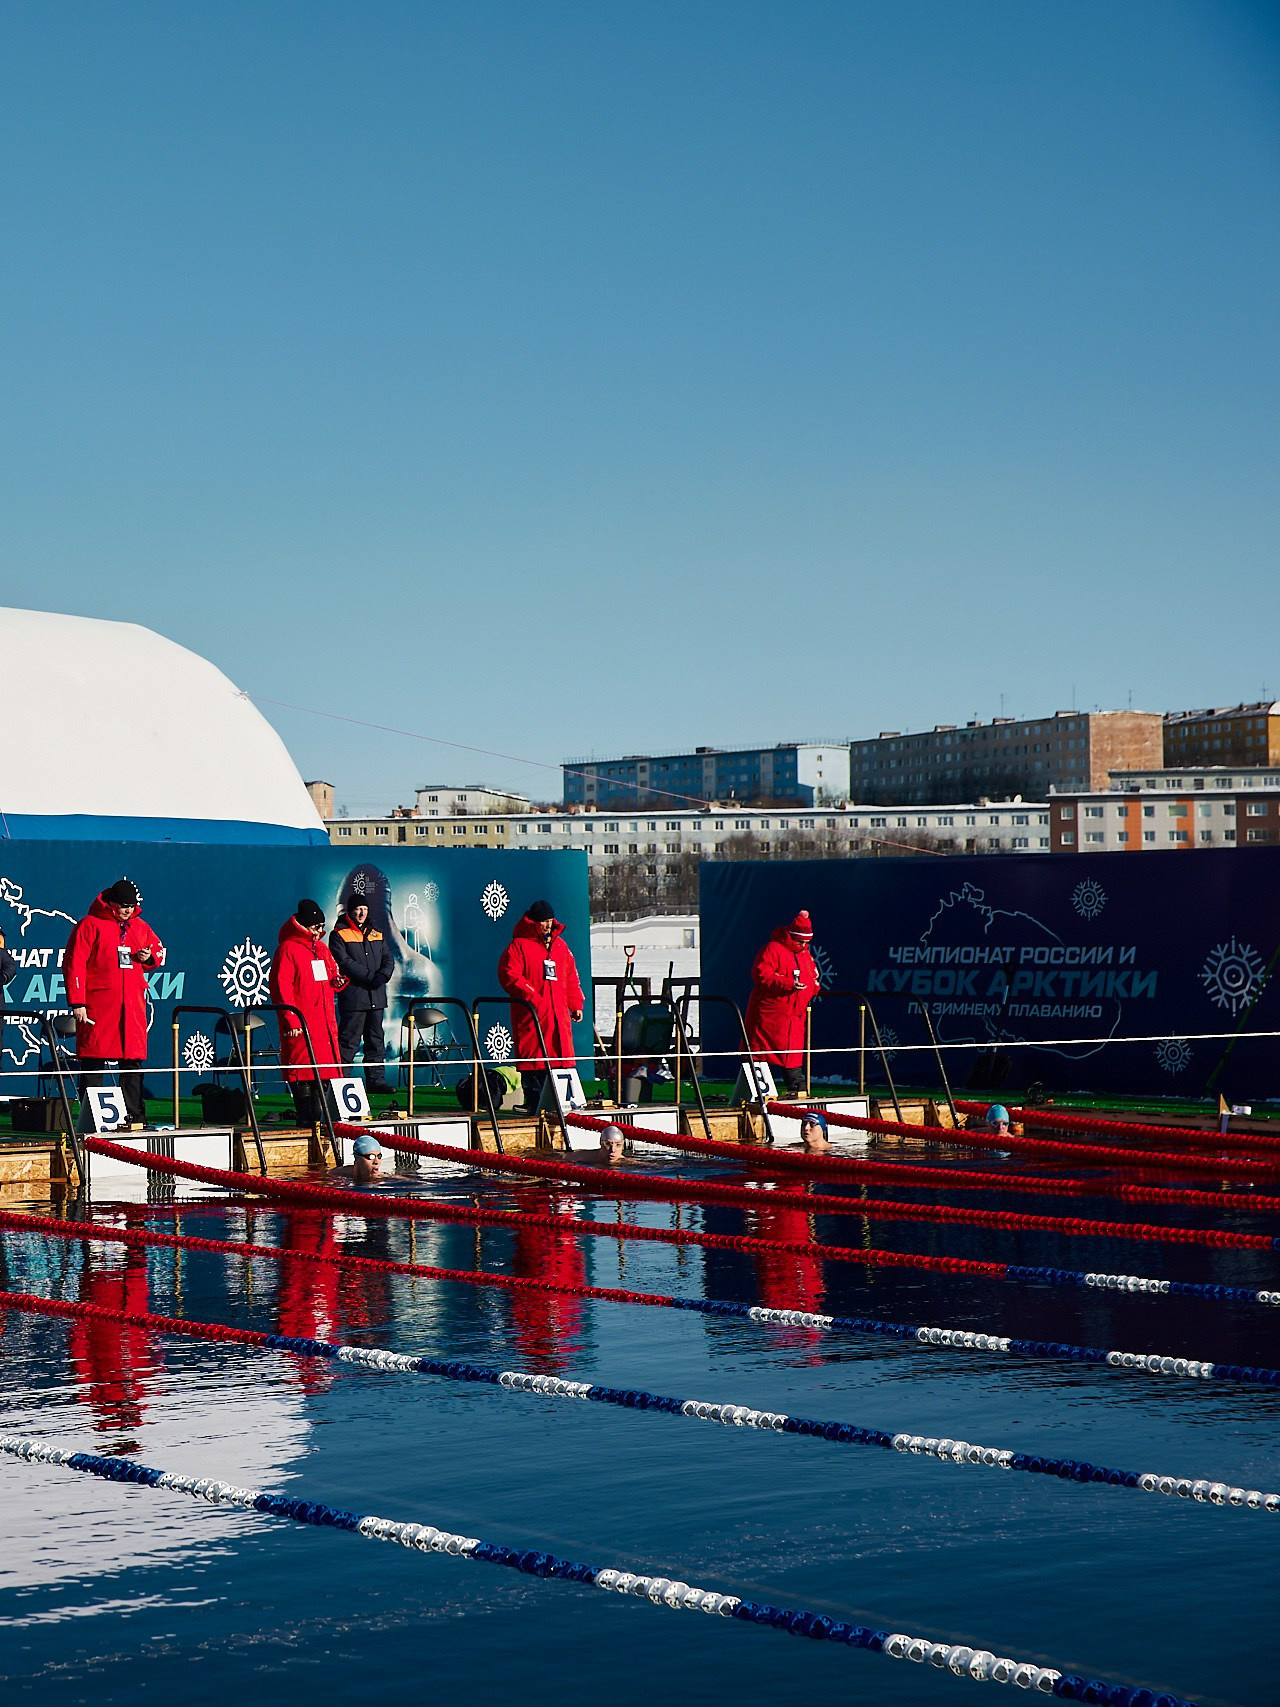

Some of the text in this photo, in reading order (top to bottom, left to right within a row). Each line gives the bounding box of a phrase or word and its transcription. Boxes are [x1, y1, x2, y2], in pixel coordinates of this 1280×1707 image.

[888, 946, 1136, 964] ЧЕМПИОНАТ РОССИИ И
[868, 969, 1159, 999] КУБОК АРКТИКИ
[932, 1002, 1001, 1016] ЗИМНЕМУ
[1007, 1004, 1102, 1018] ПЛАВАНИЮ
[341, 1083, 362, 1113] 6
[556, 1073, 573, 1102] 7
[97, 1092, 120, 1124] 5
